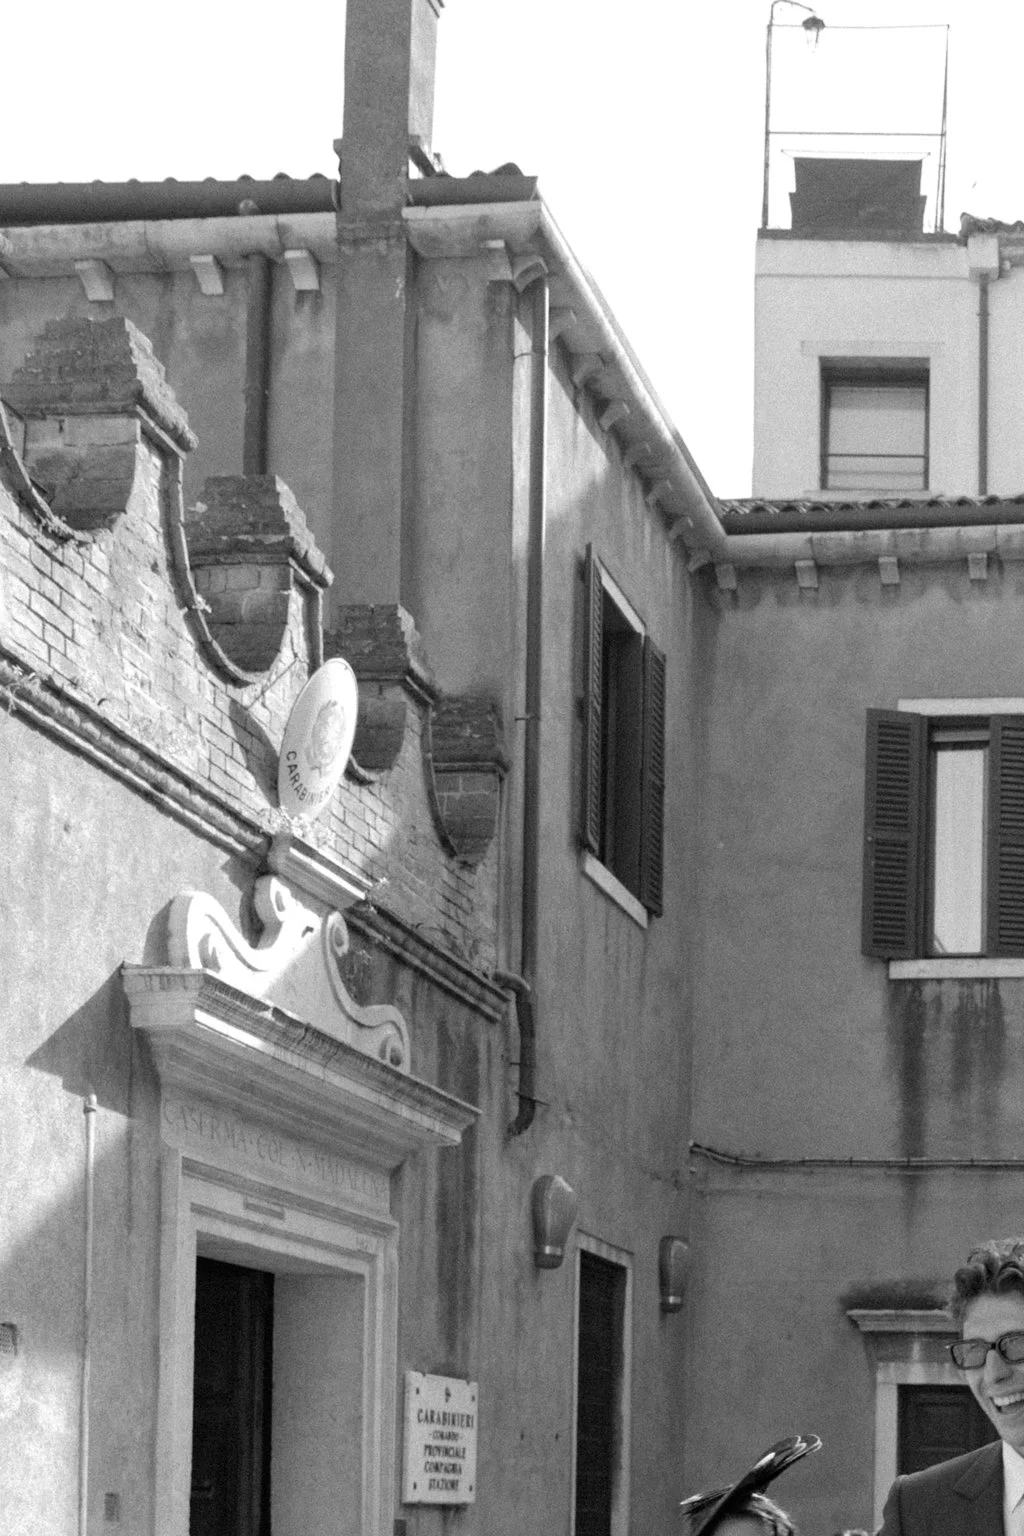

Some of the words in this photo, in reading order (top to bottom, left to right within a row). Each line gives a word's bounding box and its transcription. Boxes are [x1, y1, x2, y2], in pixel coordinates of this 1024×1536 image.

[417, 1408, 474, 1428] CARABINIERI
[424, 1444, 466, 1460] PROVINCIALE
[424, 1461, 462, 1475] COMPAGNIA
[428, 1478, 459, 1492] STAZIONE
